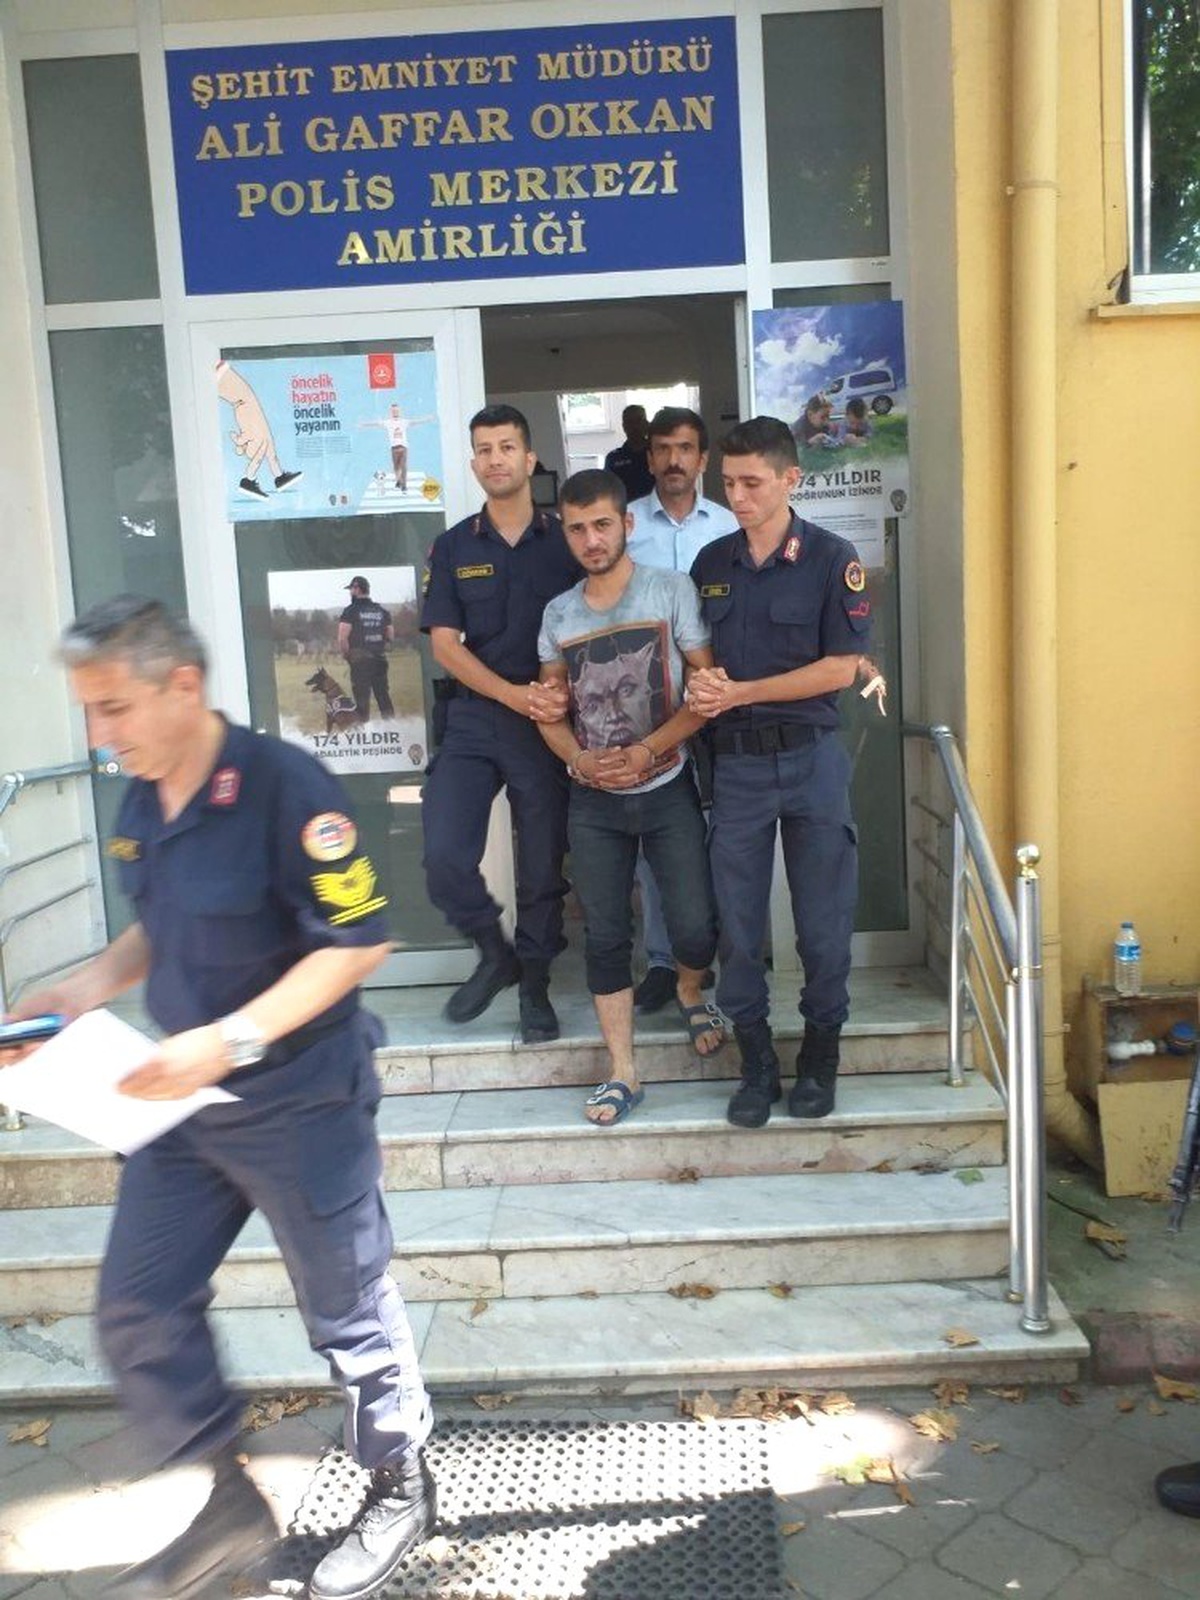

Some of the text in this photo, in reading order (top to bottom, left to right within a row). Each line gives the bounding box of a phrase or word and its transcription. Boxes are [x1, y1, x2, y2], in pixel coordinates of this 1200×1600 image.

[191, 38, 713, 109] ŞEHİT EMNİYET MÜDÜRÜ
[196, 95, 715, 161] ALİ GAFFAR OKKAN
[237, 153, 678, 219] POLİS MERKEZİ
[337, 212, 588, 267] AMİRLİĞİ
[292, 374, 334, 389] öncelik
[292, 390, 337, 405] hayatın
[294, 403, 336, 419] öncelik
[295, 420, 341, 434] yayanın
[797, 469, 882, 488] 74 YILDIR
[313, 732, 400, 747] 174 YILDIR
